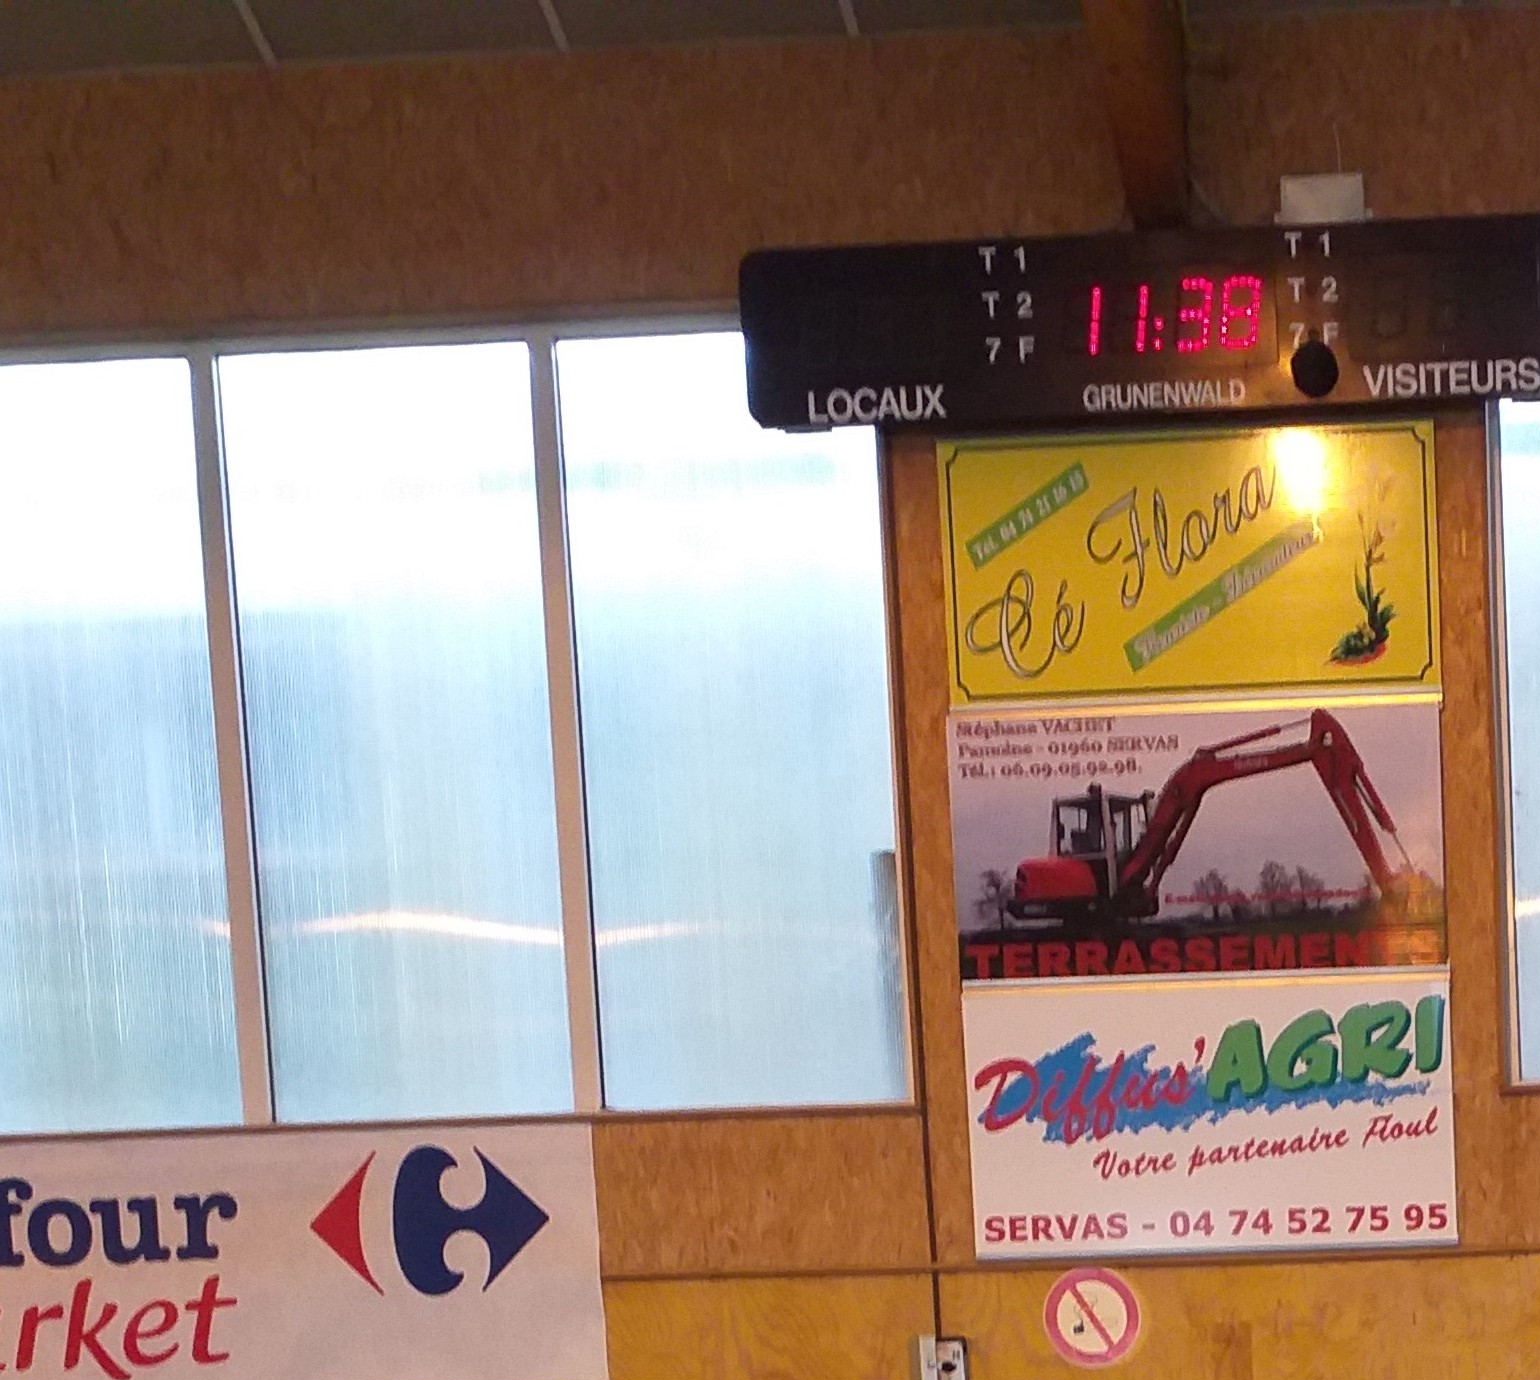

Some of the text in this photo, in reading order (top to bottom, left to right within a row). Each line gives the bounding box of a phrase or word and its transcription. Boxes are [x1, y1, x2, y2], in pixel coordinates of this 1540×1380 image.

[1285, 230, 1330, 258] T 1
[978, 246, 1025, 275] T 1
[982, 291, 1033, 319] T 2
[1287, 275, 1339, 303] T 2
[1088, 276, 1262, 354] 11:38
[986, 336, 1035, 364] 7 F
[807, 384, 947, 424] LOCAUX
[1082, 377, 1247, 413] GRUNENWALD
[1087, 462, 1276, 609] Flora
[1047, 738, 1103, 756] 01960
[1107, 734, 1179, 751] SERVAS
[1092, 1145, 1177, 1180] Votre
[1187, 1126, 1350, 1177] partenaire
[982, 1212, 1129, 1243] SERVAS
[1169, 1209, 1214, 1239] 04
[1228, 1208, 1273, 1237] 74
[1286, 1206, 1331, 1235] 52
[1344, 1205, 1389, 1234] 75
[1403, 1203, 1448, 1231] 95
